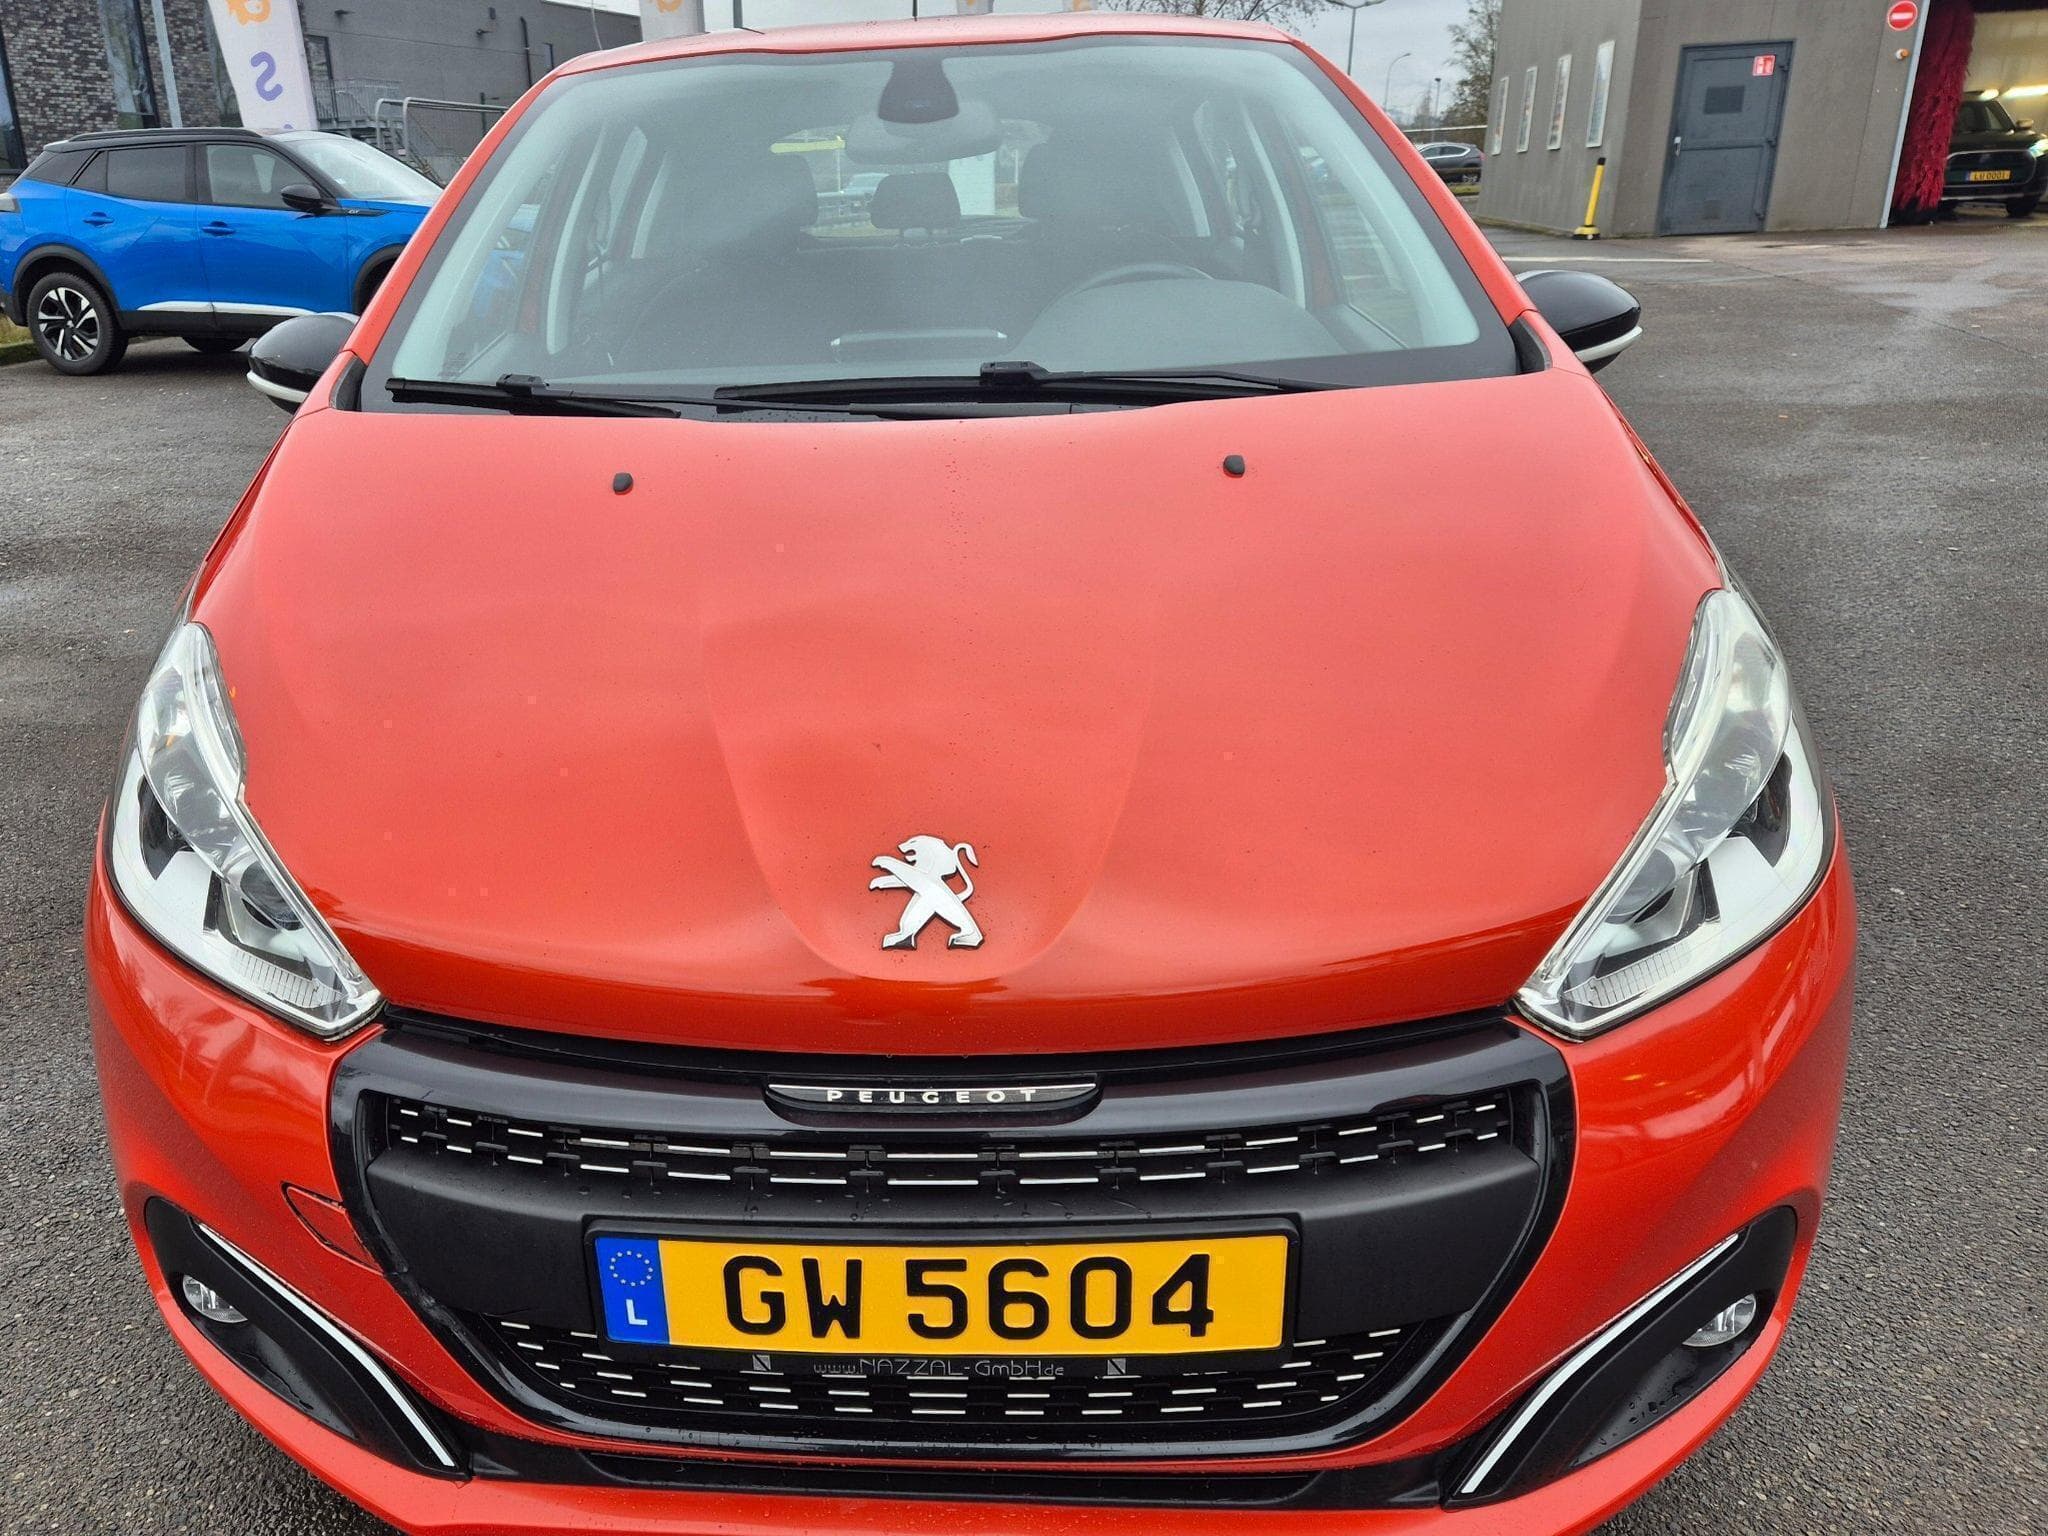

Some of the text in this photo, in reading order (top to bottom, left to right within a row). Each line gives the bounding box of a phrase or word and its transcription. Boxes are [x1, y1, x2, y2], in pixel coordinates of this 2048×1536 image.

[826, 1088, 1037, 1104] PEUGEOT
[723, 1253, 1215, 1340] GW 5604
[625, 1298, 648, 1326] L
